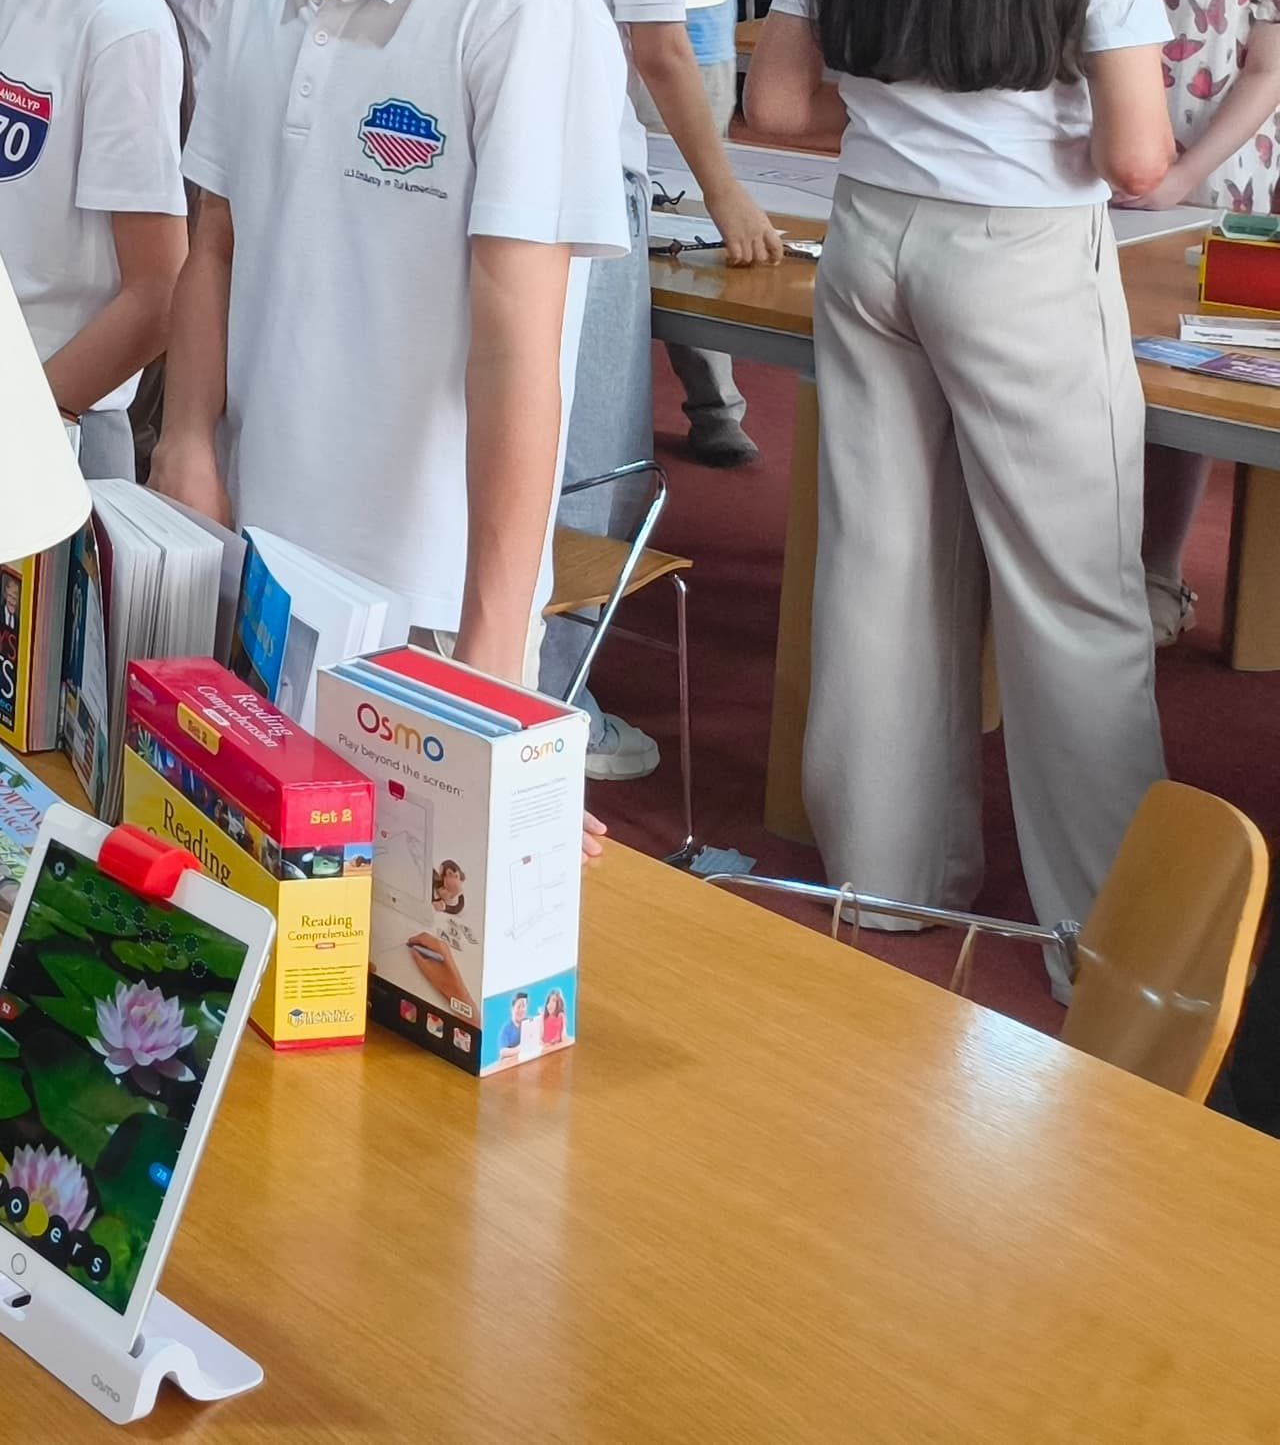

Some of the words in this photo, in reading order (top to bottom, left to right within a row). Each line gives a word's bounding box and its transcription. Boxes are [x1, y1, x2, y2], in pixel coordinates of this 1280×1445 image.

[197, 685, 278, 749] Comprehension
[231, 693, 294, 738] Reading
[201, 732, 208, 744] 2
[338, 733, 360, 753] Play
[361, 743, 400, 771] beyond
[402, 759, 421, 780] the
[309, 809, 339, 825] Set
[340, 807, 353, 823] 2
[163, 798, 232, 888] Reading
[287, 929, 364, 942] Comprehension
[301, 914, 353, 929] Reading
